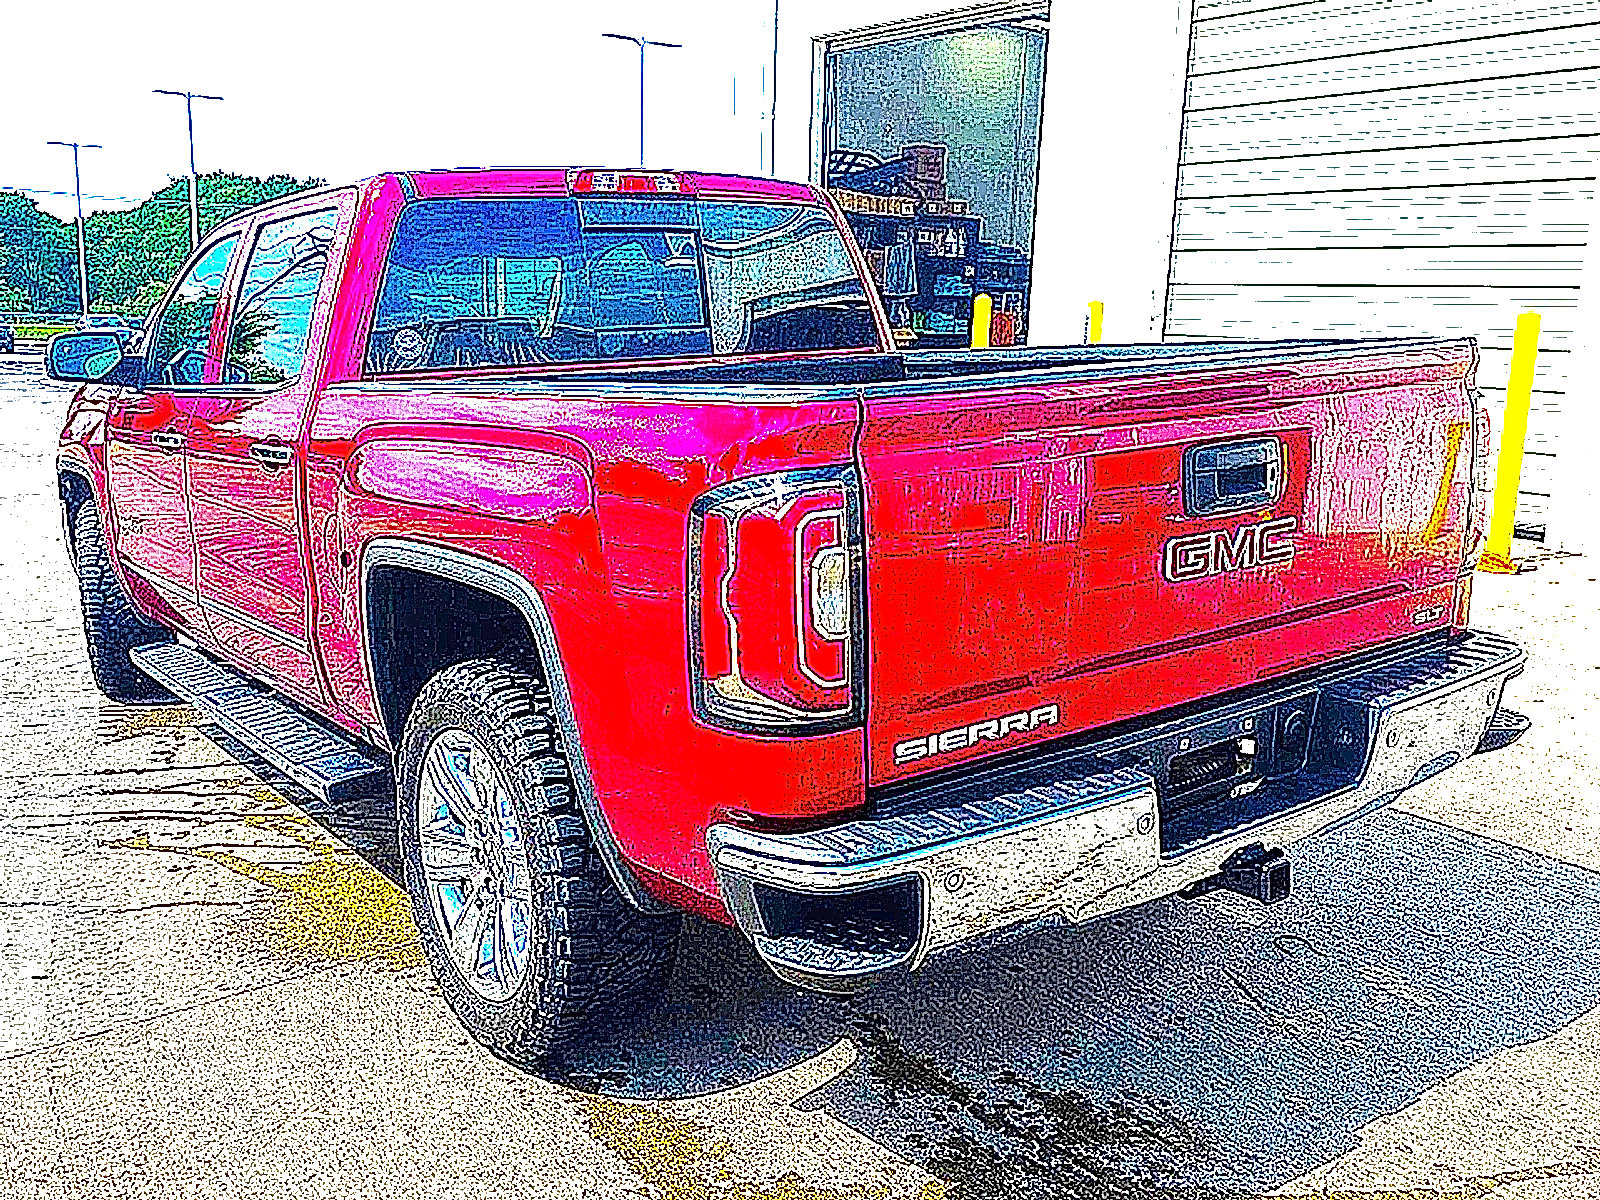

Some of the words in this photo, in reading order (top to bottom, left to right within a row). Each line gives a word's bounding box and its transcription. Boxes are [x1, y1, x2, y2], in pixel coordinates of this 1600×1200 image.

[1164, 516, 1297, 582] GMC
[1414, 606, 1444, 625] SLT
[894, 703, 1059, 765] SIERRA
